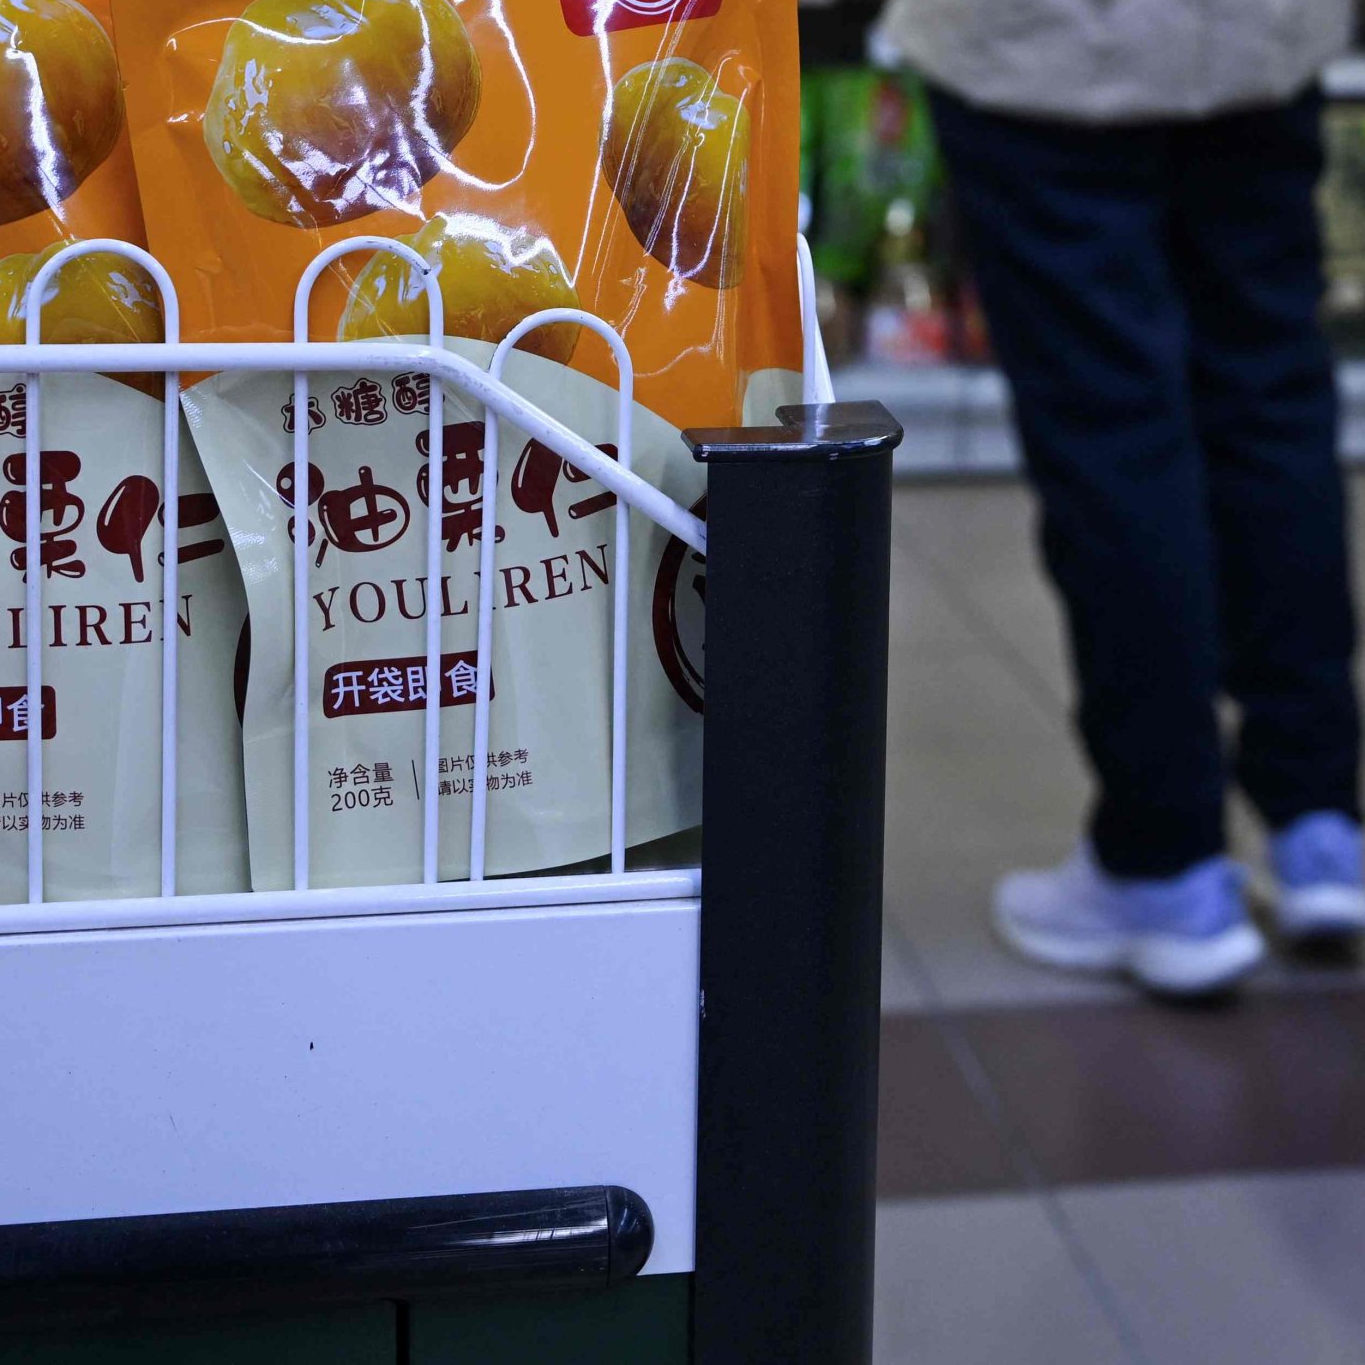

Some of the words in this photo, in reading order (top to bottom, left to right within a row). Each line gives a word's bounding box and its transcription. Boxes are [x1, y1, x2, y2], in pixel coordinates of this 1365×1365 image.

[312, 543, 610, 633] YOULREN
[331, 658, 479, 710] 开袋即食
[328, 762, 395, 789] 净含量
[331, 785, 394, 812] 200克
